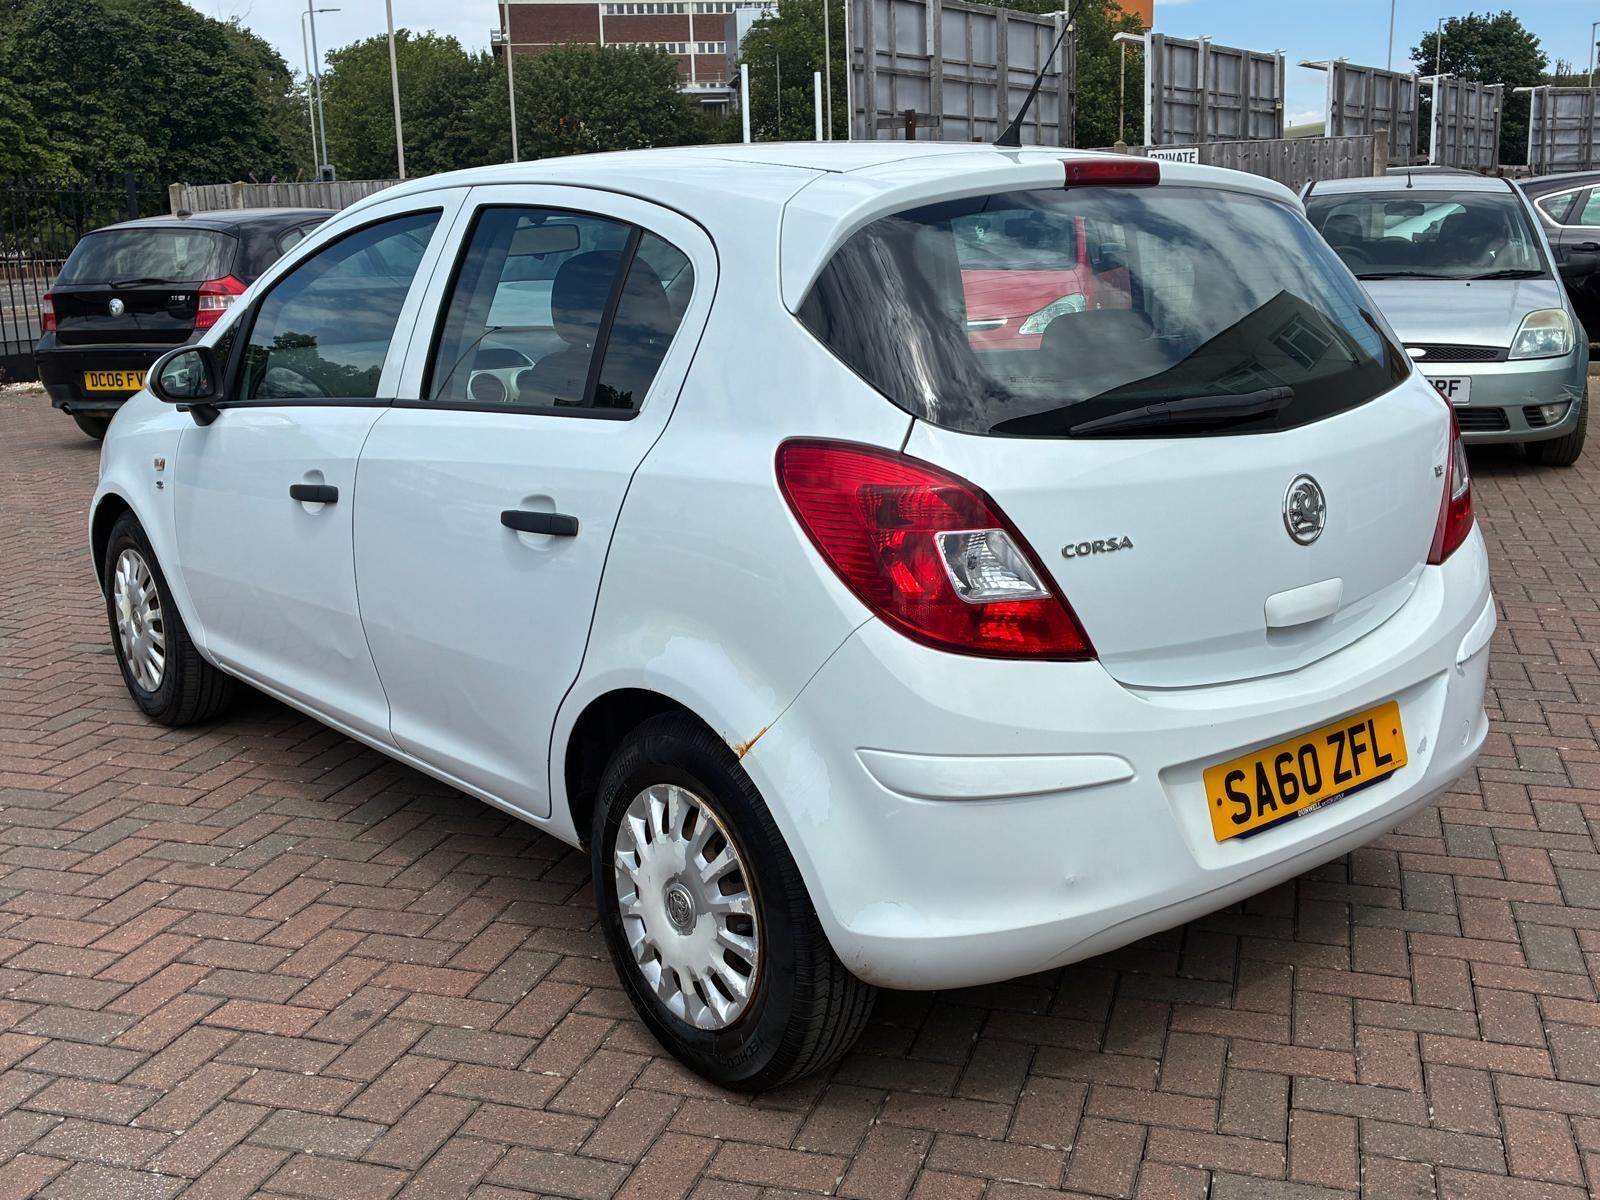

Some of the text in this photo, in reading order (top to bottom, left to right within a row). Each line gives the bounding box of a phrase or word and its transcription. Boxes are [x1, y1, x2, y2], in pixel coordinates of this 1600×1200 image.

[91, 373, 147, 388] DC06 FV
[1061, 535, 1134, 559] CORSA
[1224, 718, 1393, 825] SA60 ZFL
